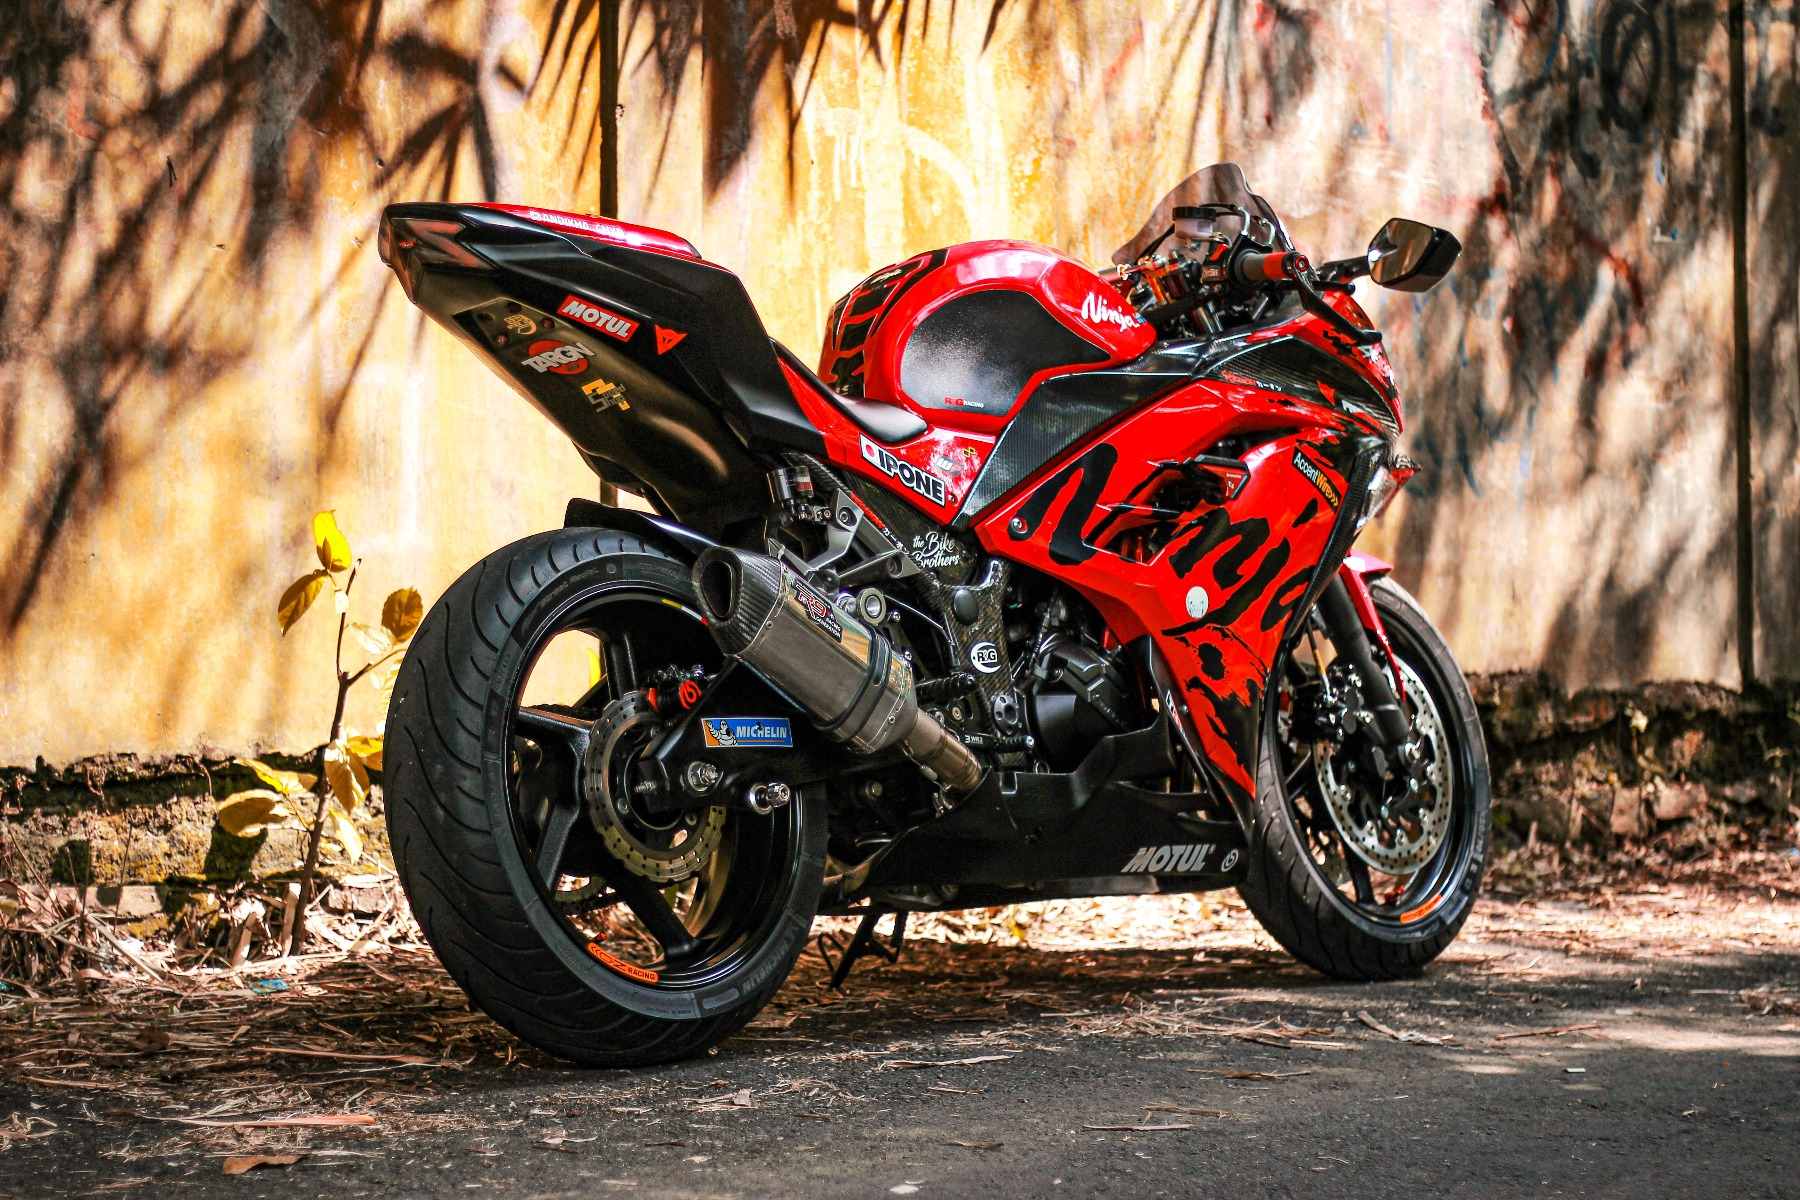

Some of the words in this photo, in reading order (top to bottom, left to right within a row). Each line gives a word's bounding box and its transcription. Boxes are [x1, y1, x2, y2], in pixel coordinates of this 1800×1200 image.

[562, 300, 632, 338] MOTUL
[1081, 291, 1140, 332] Ninja
[878, 448, 944, 503] IPONE
[912, 535, 925, 549] the
[922, 531, 956, 557] Bike
[1007, 442, 1318, 637] Nnja
[977, 649, 998, 662] R&G
[736, 726, 787, 738] MICHELIN
[627, 966, 656, 980] RACING
